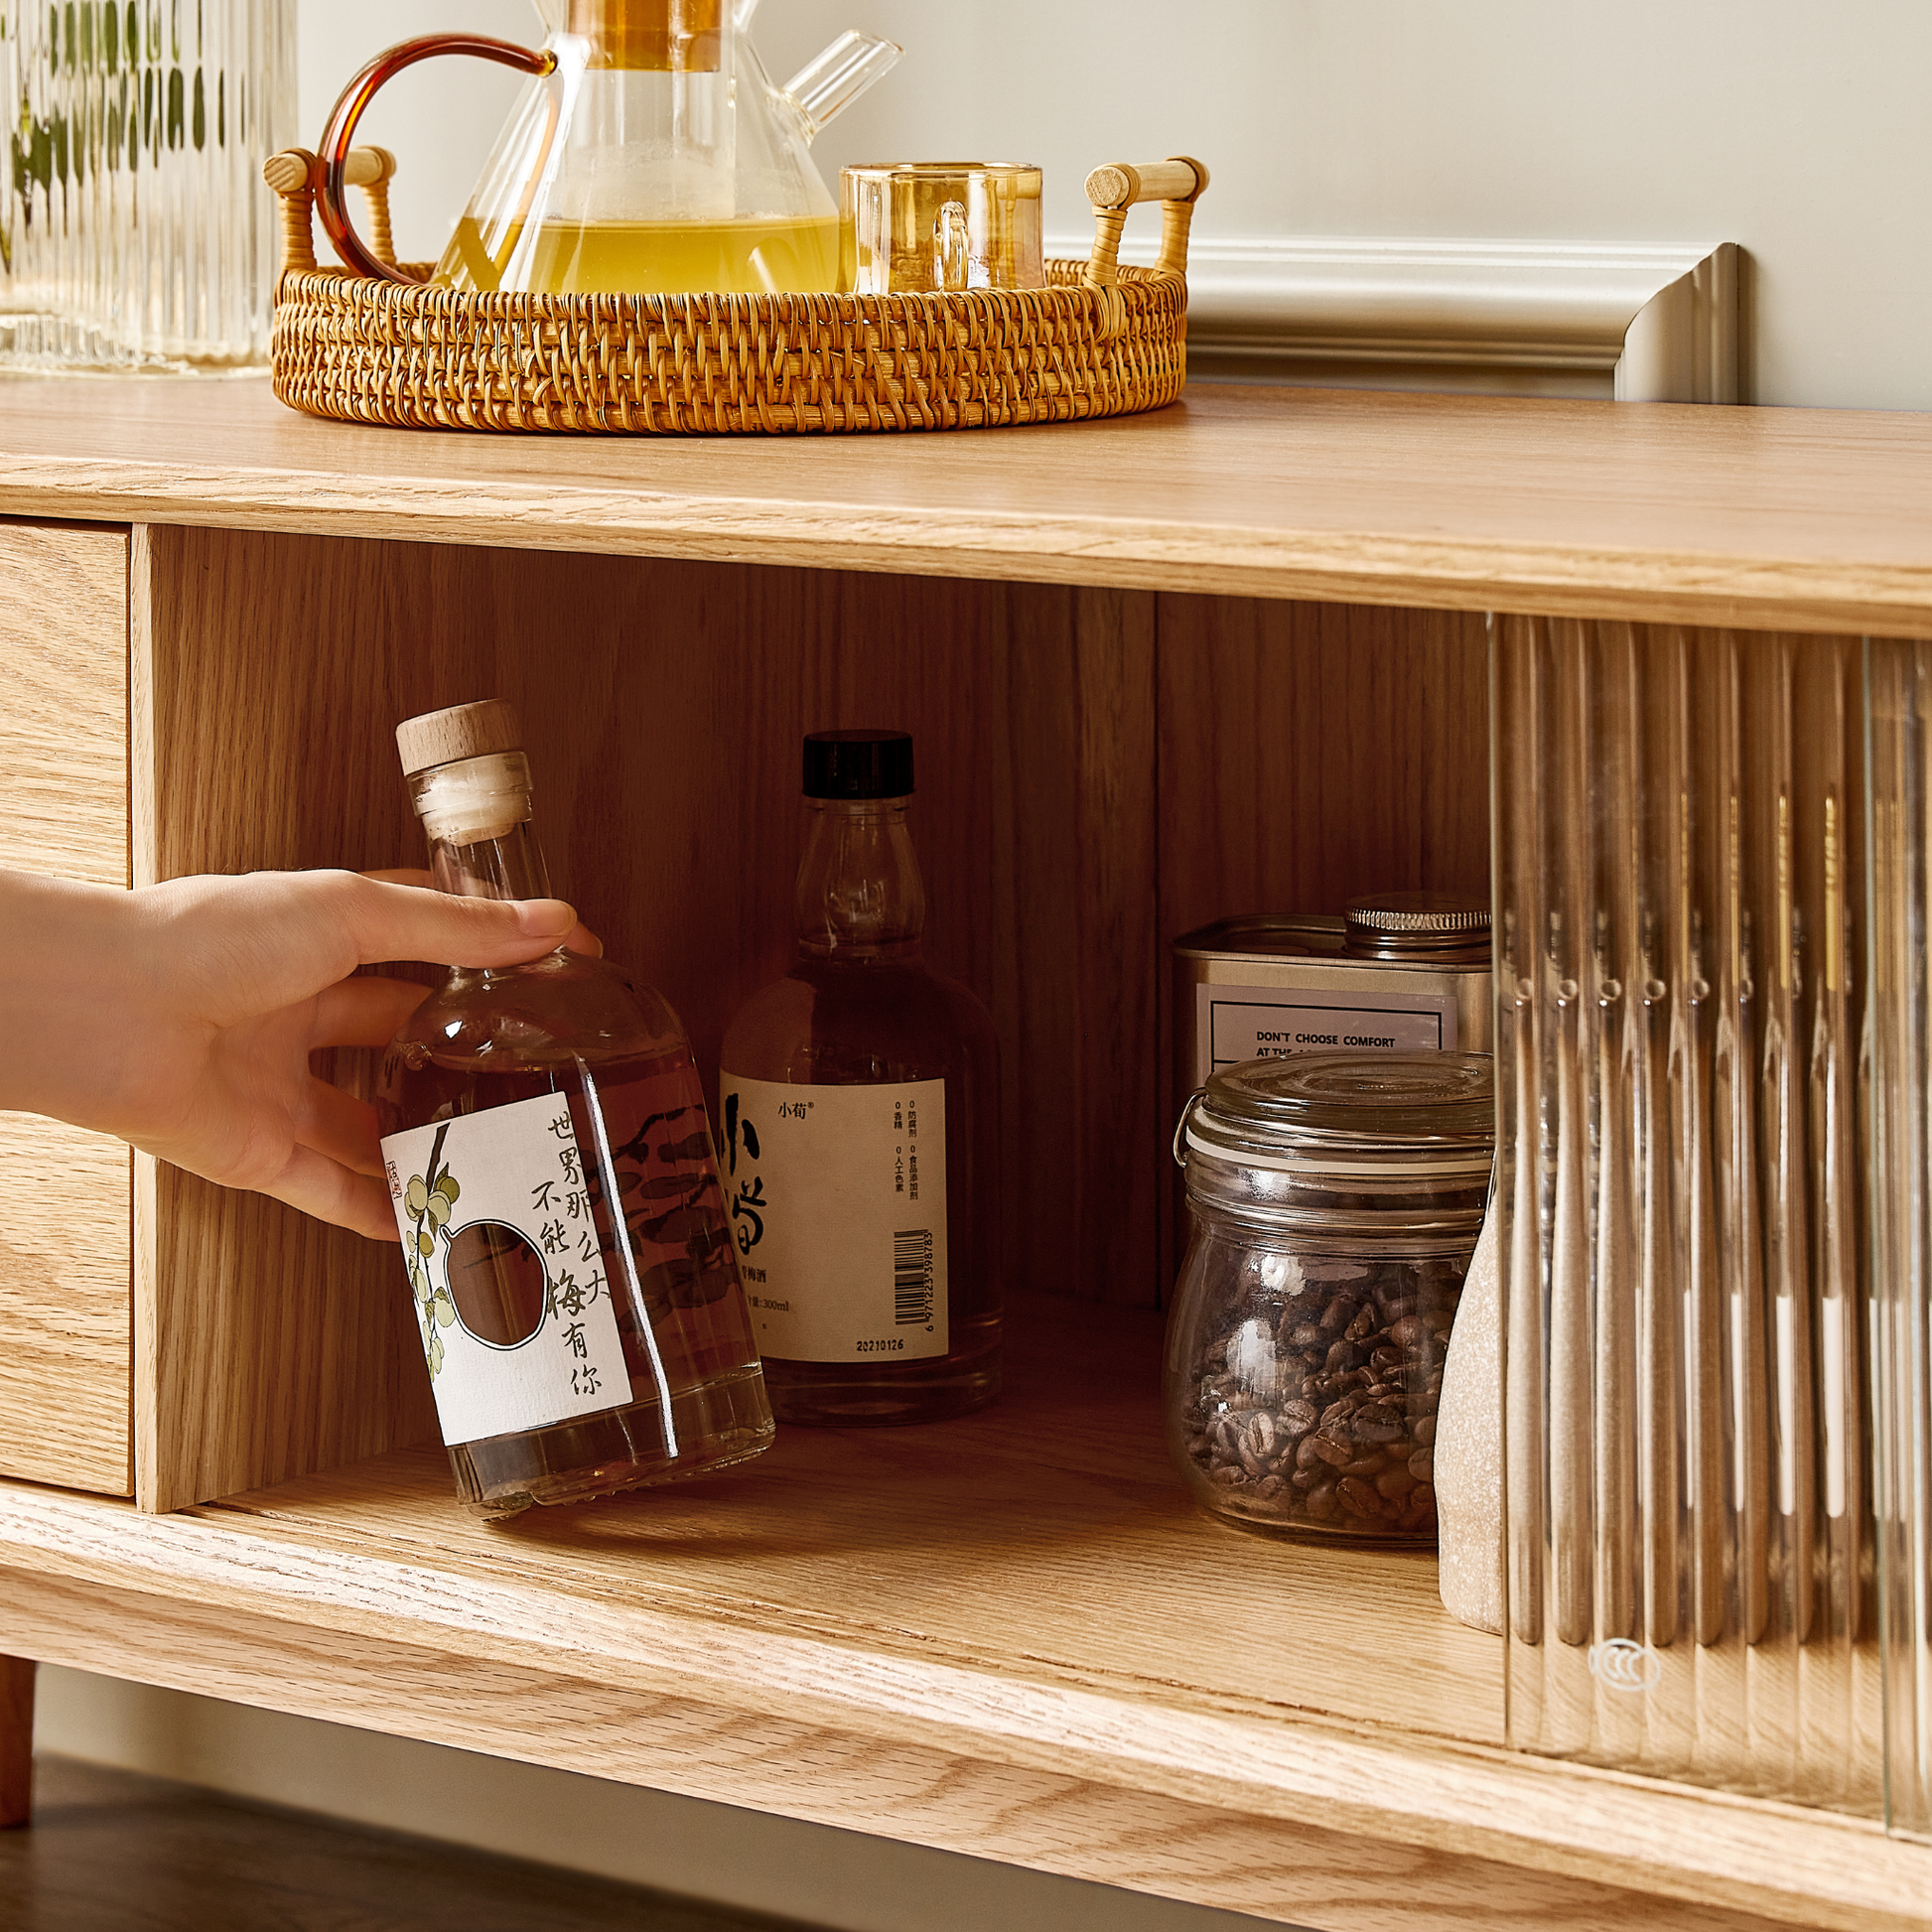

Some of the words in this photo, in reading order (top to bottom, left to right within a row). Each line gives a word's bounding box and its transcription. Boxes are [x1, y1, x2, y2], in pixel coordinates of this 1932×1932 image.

[1257, 1032, 1291, 1042] DON'T
[1296, 1034, 1338, 1045] CHOOSE
[1343, 1035, 1396, 1048] COMFORT
[1256, 1047, 1270, 1057] AT
[547, 1110, 612, 1306] 世界那么大
[856, 1339, 904, 1352] 20210126
